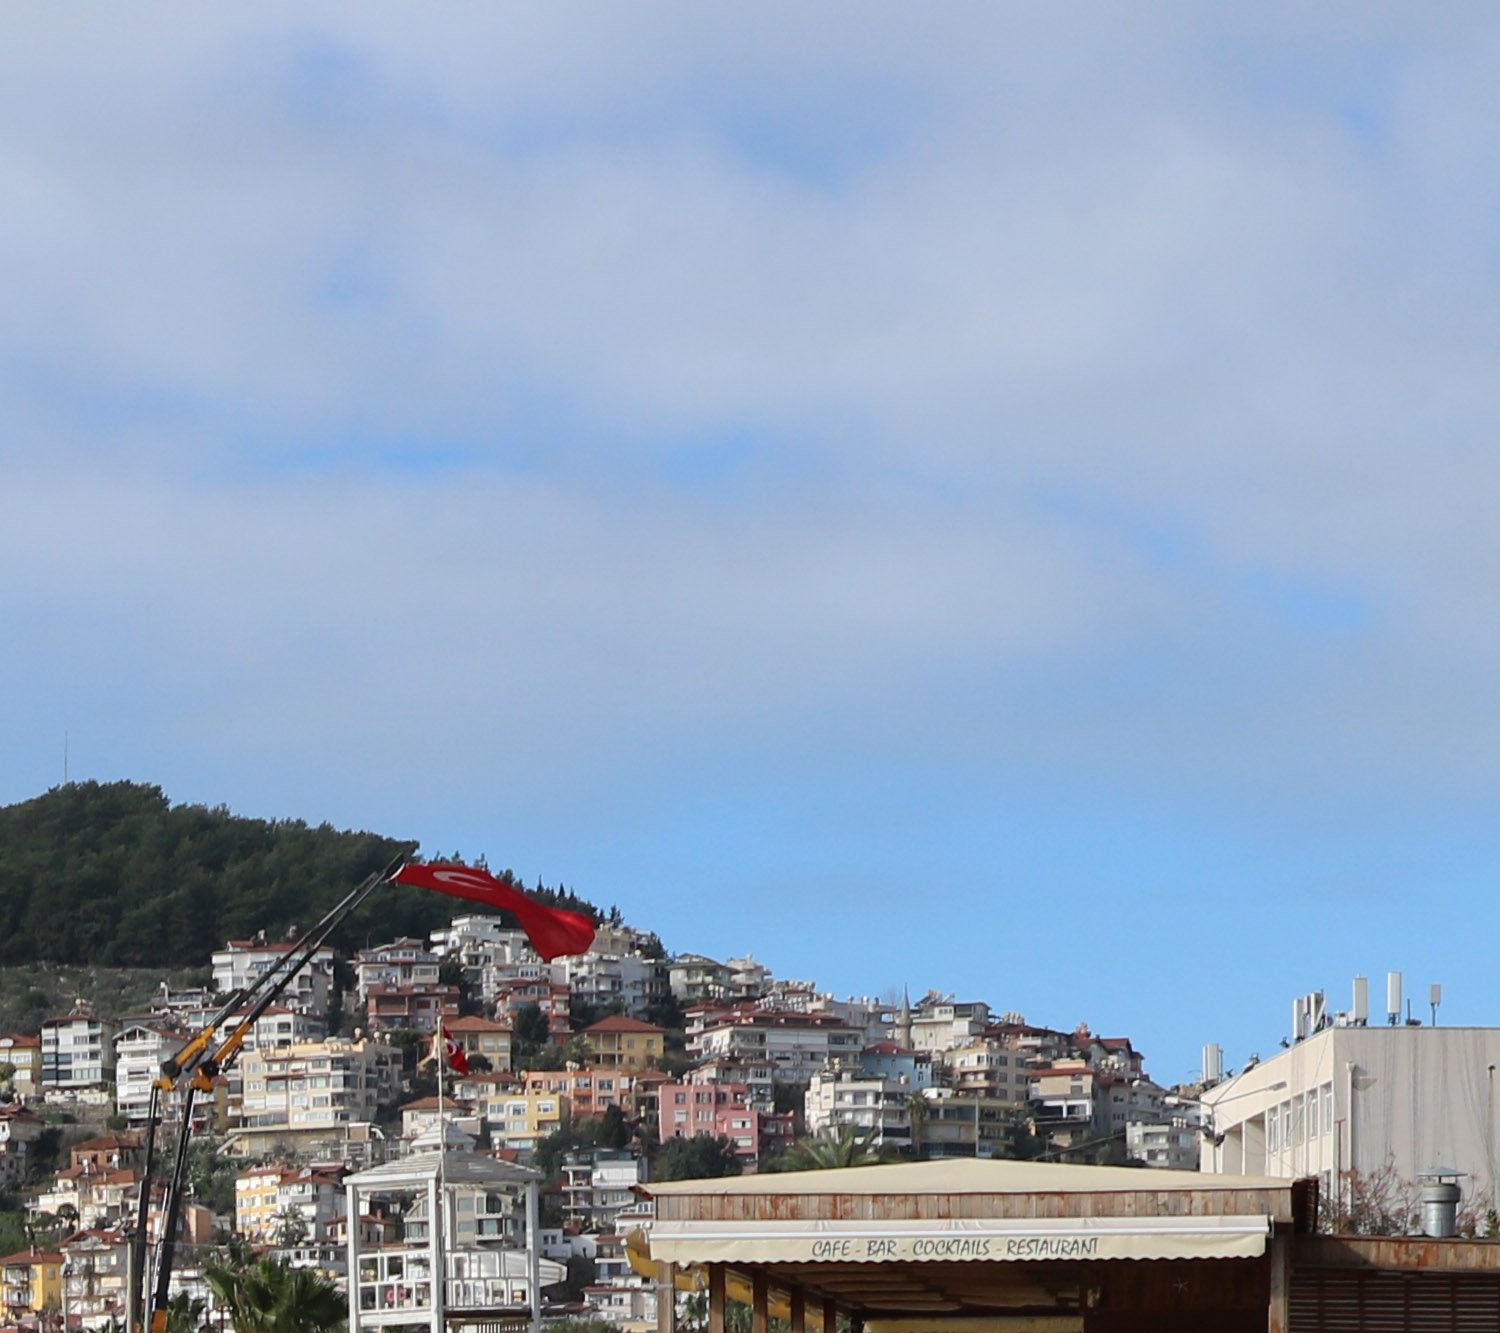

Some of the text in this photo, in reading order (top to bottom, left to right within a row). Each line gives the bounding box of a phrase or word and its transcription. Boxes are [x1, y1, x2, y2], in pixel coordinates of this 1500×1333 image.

[811, 1240, 851, 1257] CAFE
[867, 1239, 897, 1256] BAR
[912, 1239, 990, 1256] COCKTAILS
[1007, 1237, 1099, 1255] RESTAURANT
